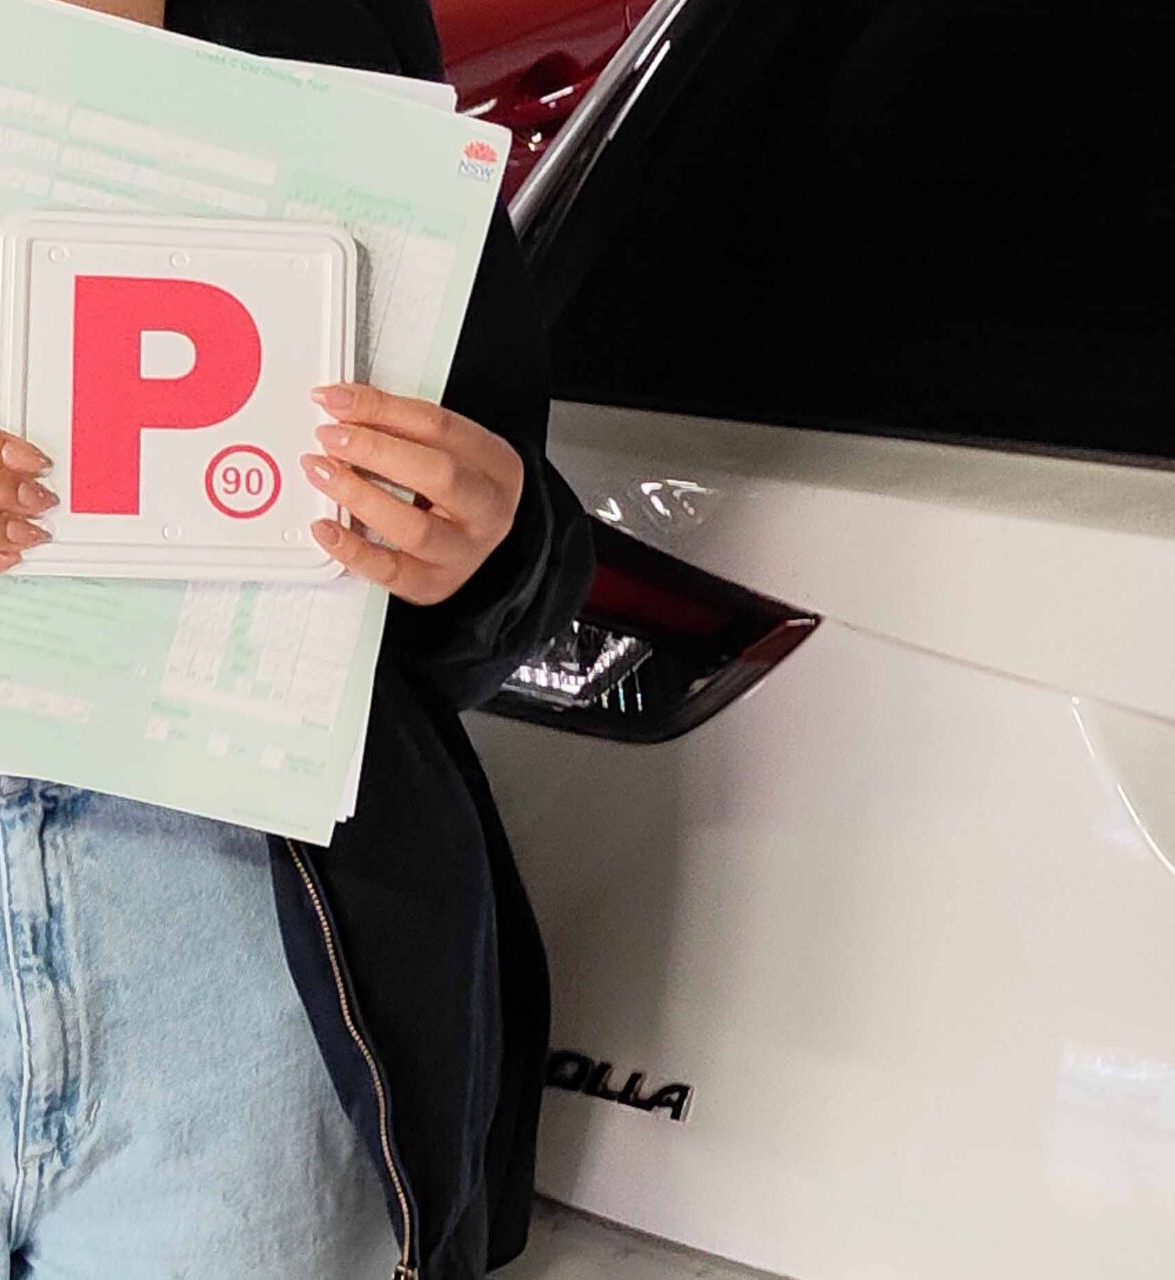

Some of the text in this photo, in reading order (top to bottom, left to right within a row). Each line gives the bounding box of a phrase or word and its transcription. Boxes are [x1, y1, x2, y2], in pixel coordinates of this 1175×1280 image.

[458, 159, 495, 178] NSW
[71, 274, 263, 516] P
[221, 466, 263, 496] 90
[543, 1050, 694, 1122] OLLA
